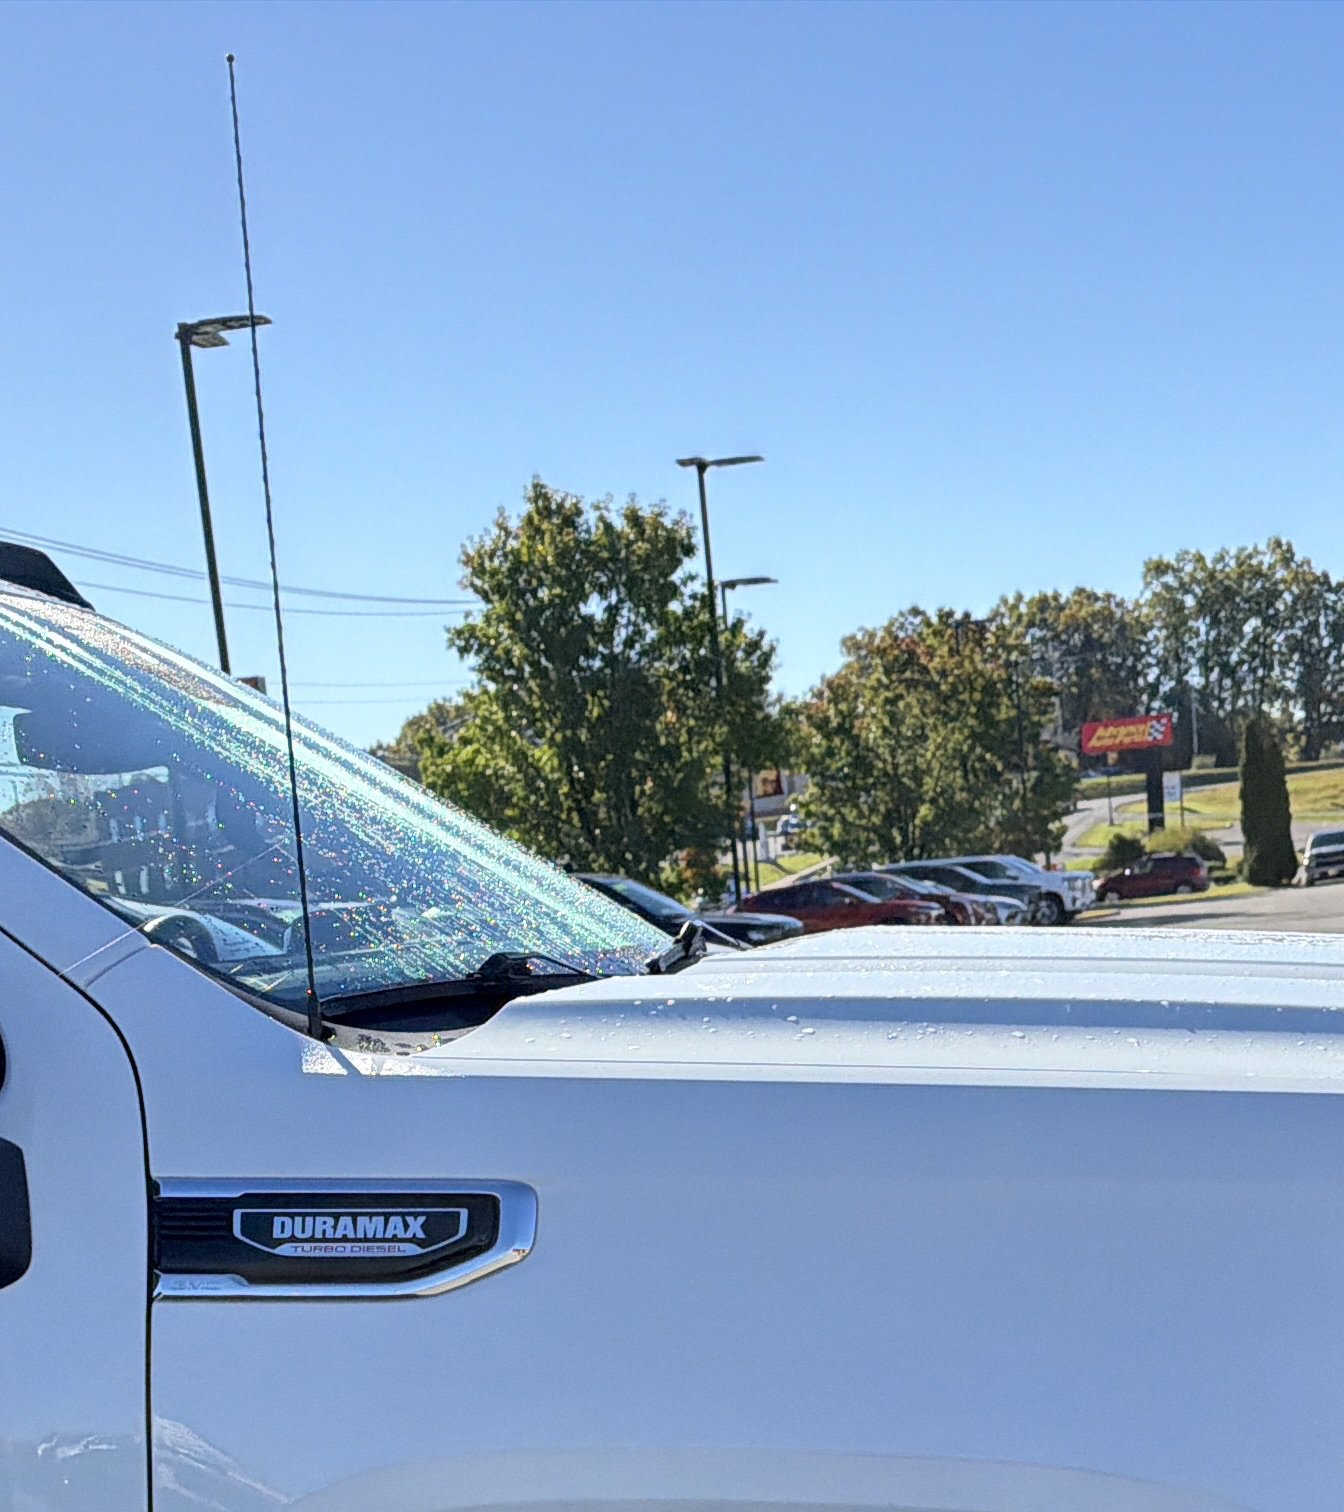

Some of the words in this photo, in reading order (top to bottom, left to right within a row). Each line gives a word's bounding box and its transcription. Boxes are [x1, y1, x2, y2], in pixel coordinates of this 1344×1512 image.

[272, 1215, 427, 1239] DURAMAX
[290, 1244, 347, 1254] TURBO
[349, 1244, 407, 1254] DIESEL
